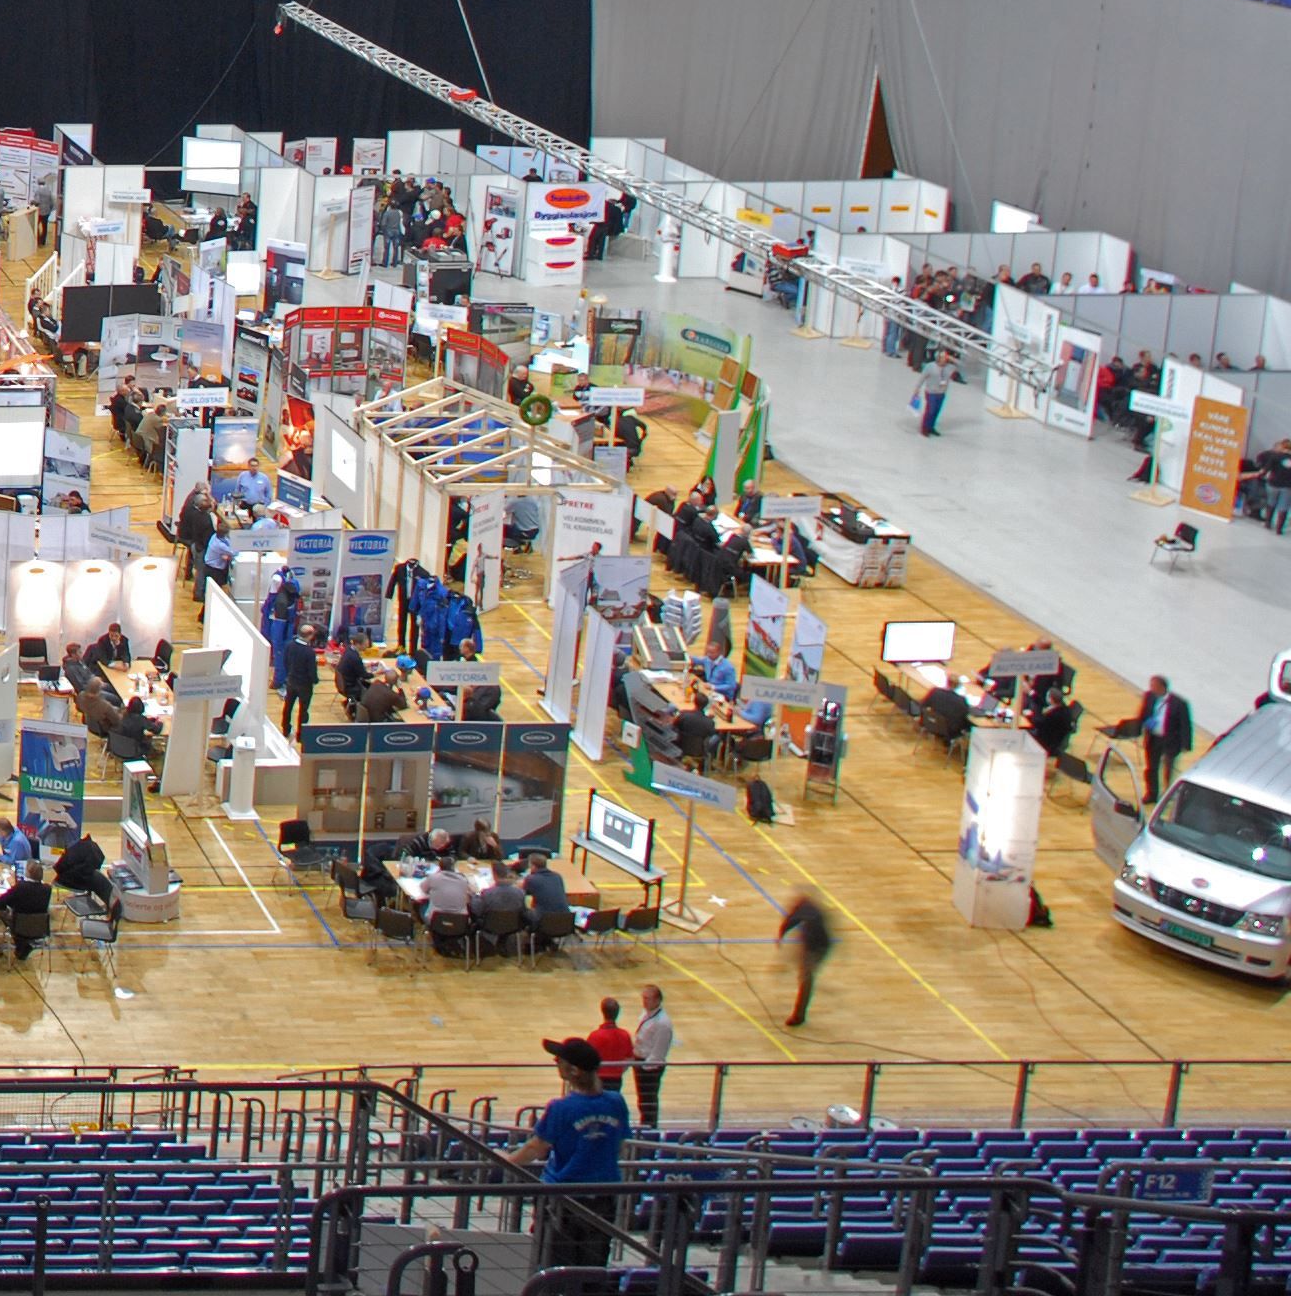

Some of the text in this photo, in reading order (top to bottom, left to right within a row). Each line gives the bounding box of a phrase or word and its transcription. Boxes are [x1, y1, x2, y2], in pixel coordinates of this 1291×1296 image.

[564, 499, 595, 510] PRETRE
[562, 515, 607, 526] VELKOMMEN
[252, 540, 270, 548] KVT
[295, 538, 333, 549] VICTORIA
[349, 539, 388, 550] VICTORIA
[439, 674, 489, 682] VICTORIA
[755, 688, 811, 704] LAFARGE
[29, 775, 74, 792] VINDU
[1144, 1174, 1177, 1190] F12
